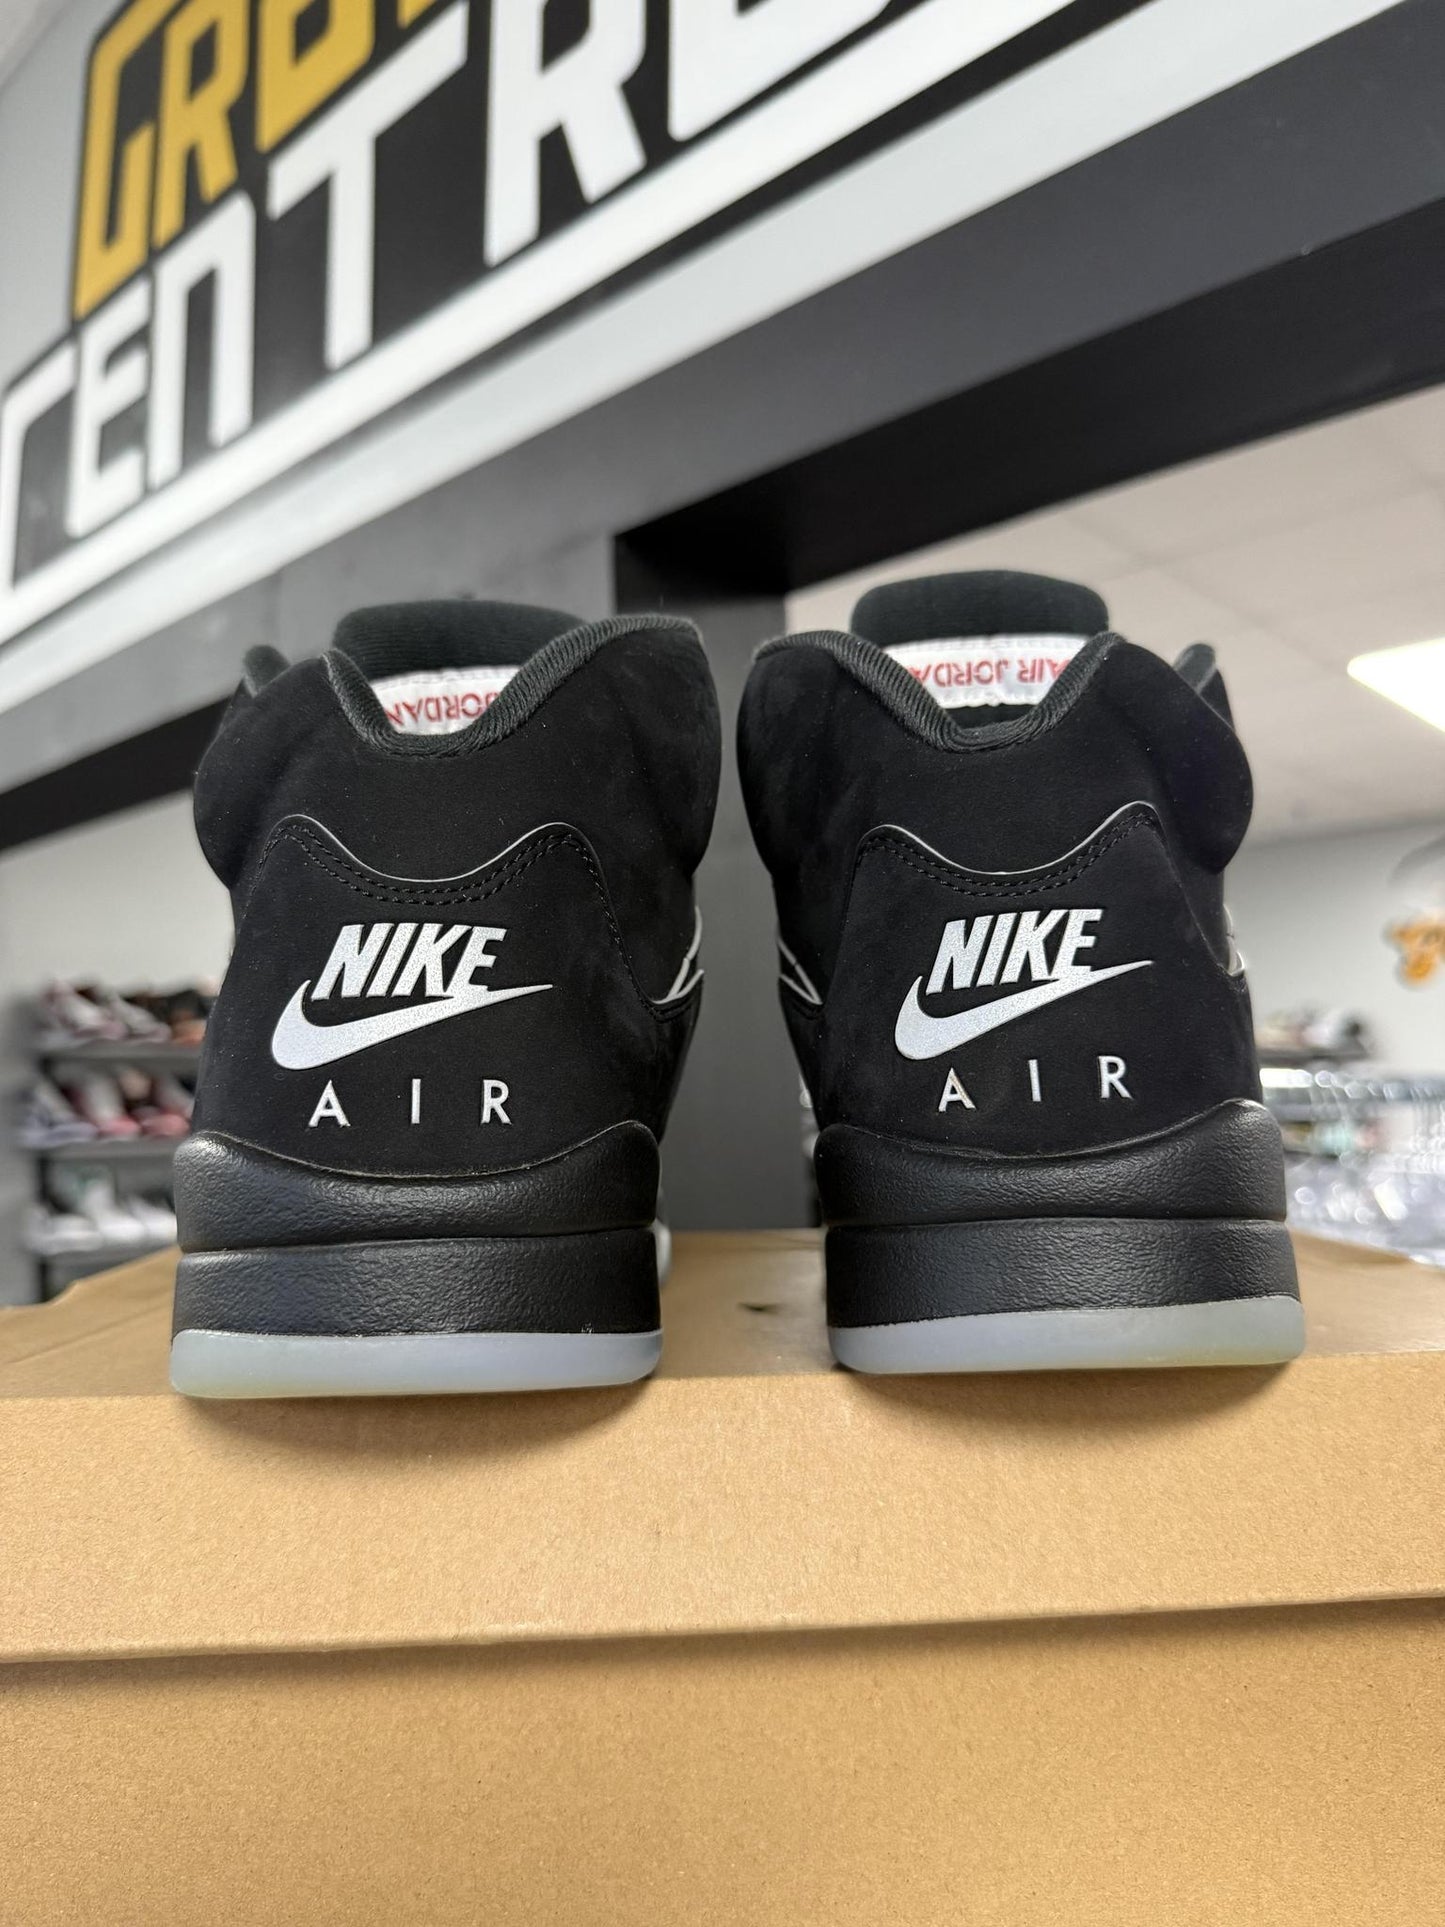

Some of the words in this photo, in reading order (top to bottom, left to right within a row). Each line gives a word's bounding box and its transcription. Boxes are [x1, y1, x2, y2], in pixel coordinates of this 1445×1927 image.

[73, 0, 442, 322] GRO
[0, 0, 892, 602] CENTR
[908, 658, 1010, 688] JORDA
[1016, 658, 1073, 684] AIR
[310, 922, 508, 1002] NIKE
[925, 908, 1104, 996] NIKE
[307, 1077, 513, 1128] AIR
[937, 1054, 1134, 1113] AIR
